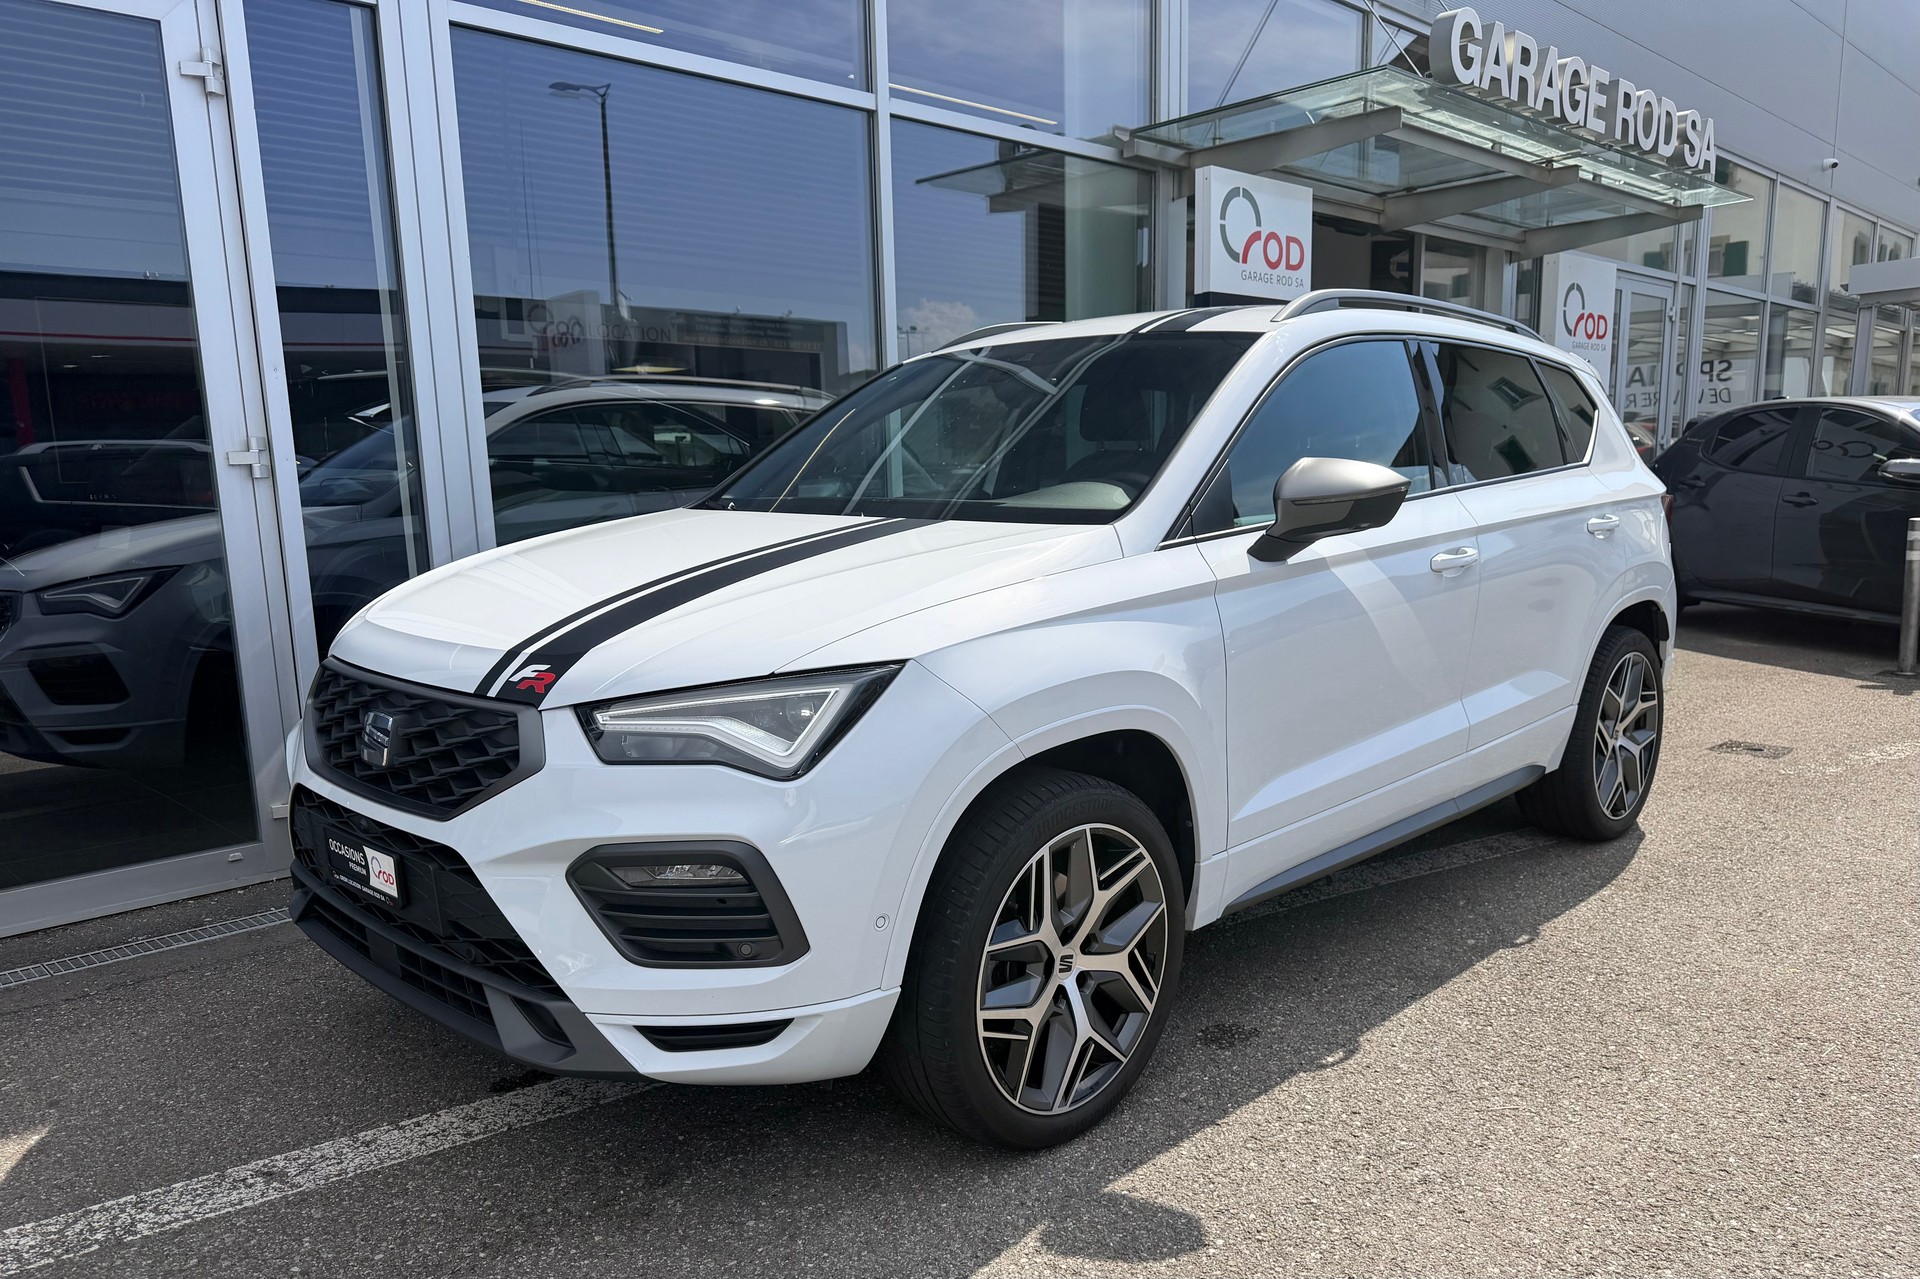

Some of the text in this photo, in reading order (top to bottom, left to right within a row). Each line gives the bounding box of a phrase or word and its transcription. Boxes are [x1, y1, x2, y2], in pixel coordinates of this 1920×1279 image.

[1449, 6, 1716, 174] GARAGE ROD SA
[1240, 269, 1304, 289] GARAGE ROD SA
[1571, 341, 1607, 352] GARAGE ROD SA
[508, 664, 556, 694] FR
[329, 839, 365, 865] OCCASIONS
[348, 861, 367, 876] PREMIUM
